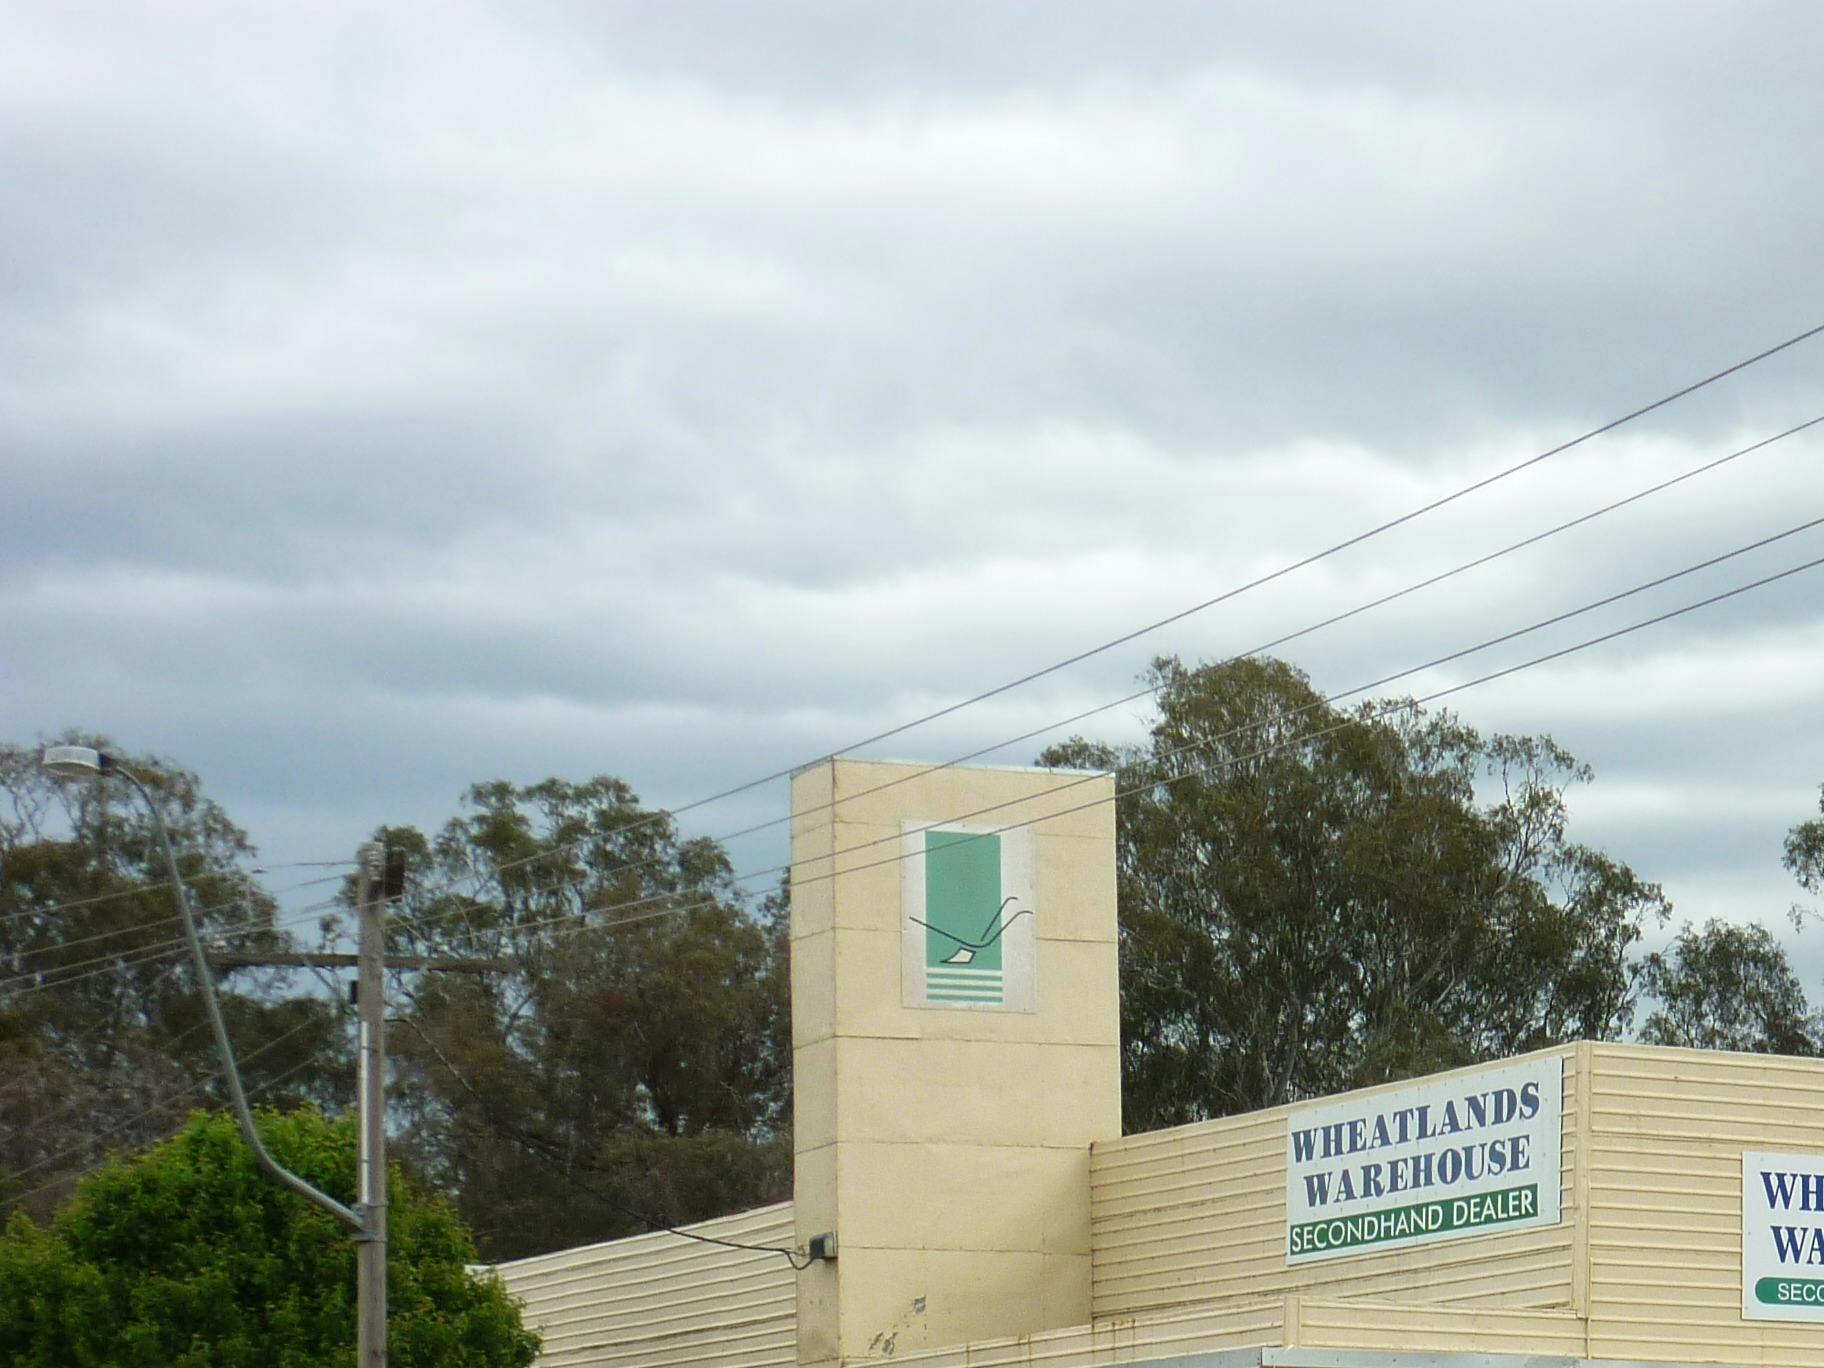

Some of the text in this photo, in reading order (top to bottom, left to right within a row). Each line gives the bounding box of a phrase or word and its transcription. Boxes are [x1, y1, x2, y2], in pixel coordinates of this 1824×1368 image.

[1291, 1081, 1541, 1165] WHEATLANDS
[1303, 1134, 1531, 1208] WAREHOUSE
[1290, 1189, 1535, 1255] SECONDHAND DEALER
